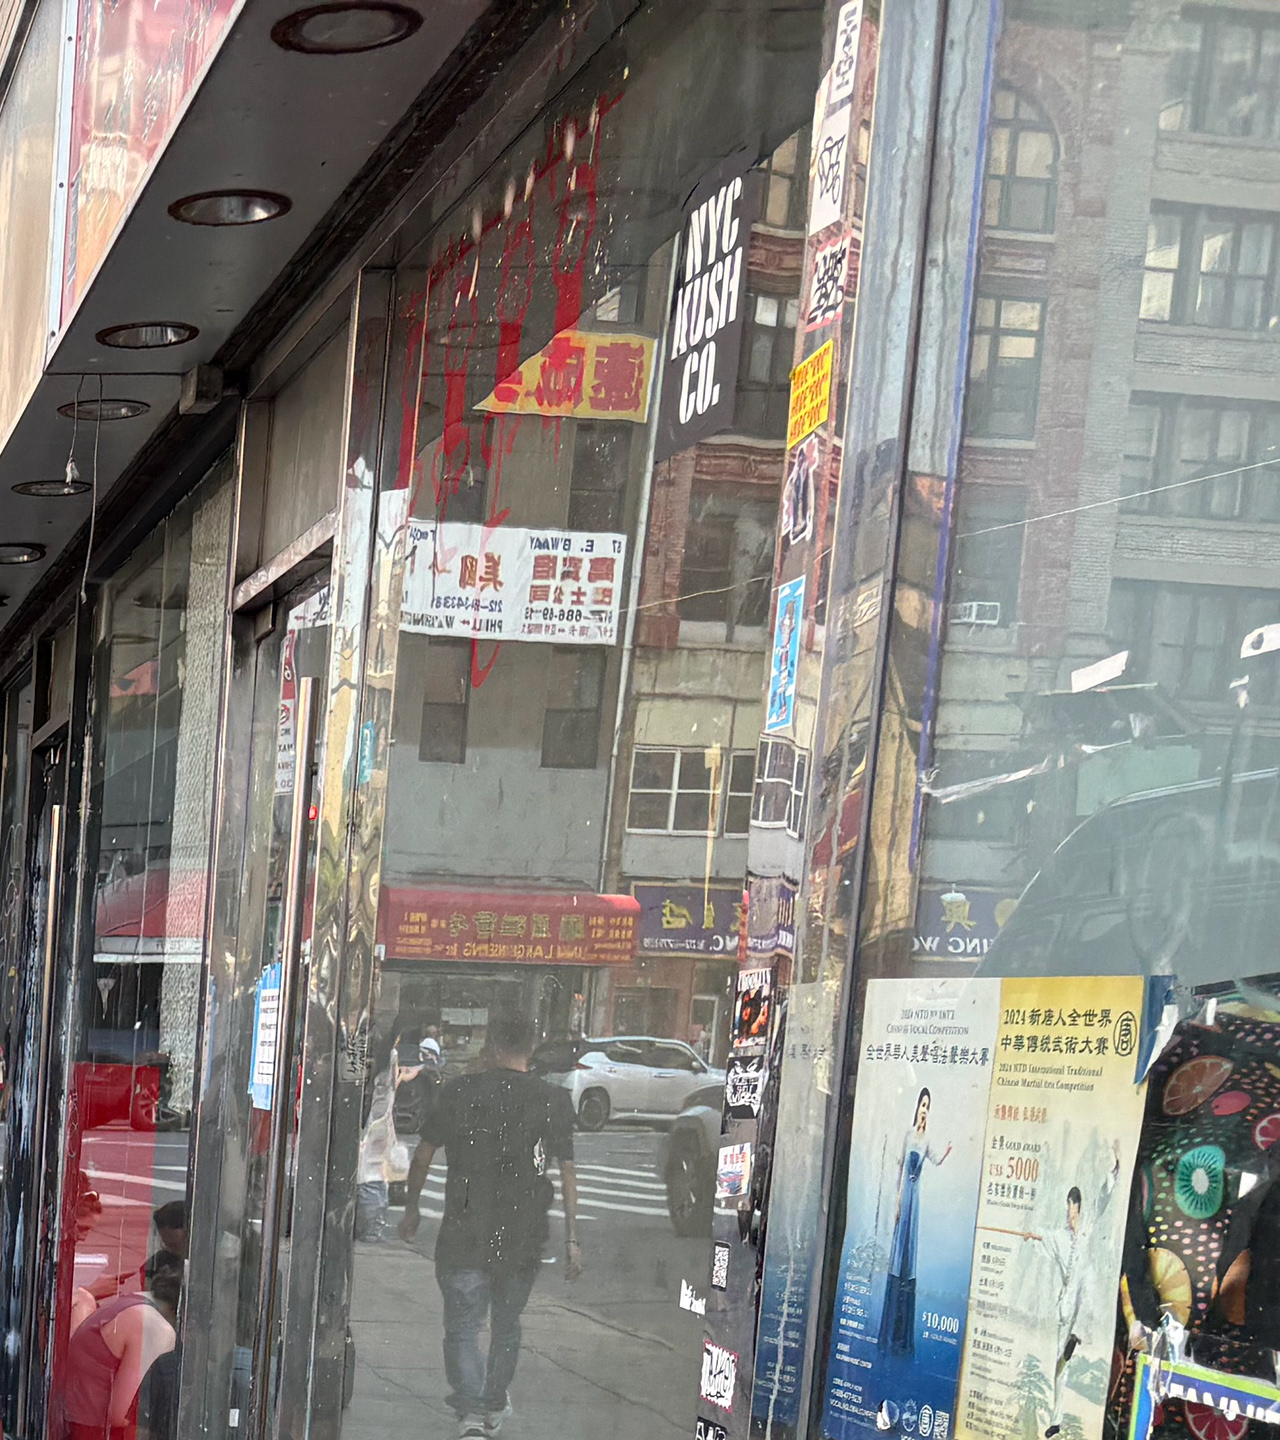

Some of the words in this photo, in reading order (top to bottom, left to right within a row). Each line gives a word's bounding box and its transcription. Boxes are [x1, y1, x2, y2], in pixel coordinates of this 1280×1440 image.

[685, 177, 742, 282] NYC
[671, 246, 743, 360] KUSH
[679, 340, 720, 424] CO.
[1003, 1009, 1026, 1025] 2024
[1029, 1008, 1112, 1028] 新唐人全世界
[1007, 1157, 1039, 1182] 5000
[922, 1311, 959, 1334] $10,000
